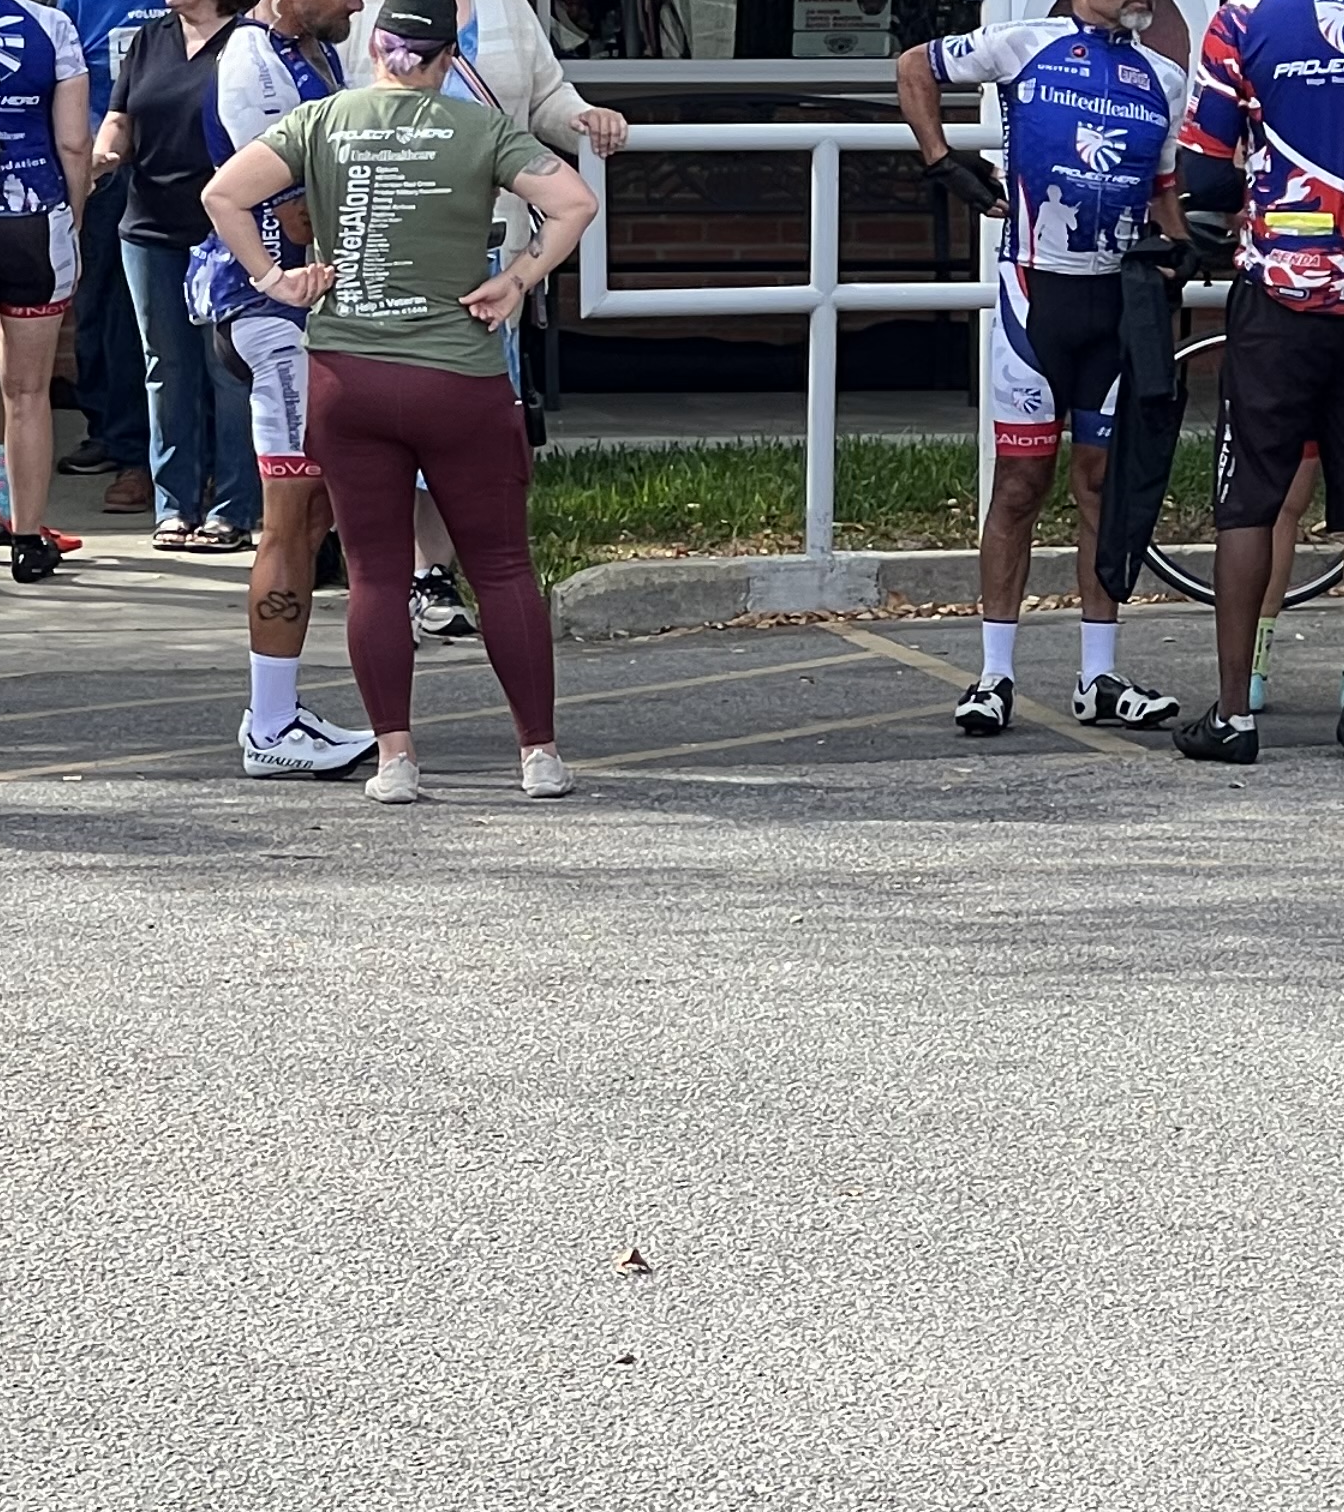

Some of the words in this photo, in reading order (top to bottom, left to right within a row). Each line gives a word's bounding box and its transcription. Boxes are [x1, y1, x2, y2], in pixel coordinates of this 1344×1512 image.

[1037, 64, 1078, 74] UNITED
[350, 149, 438, 162] UnitedHealthcare
[332, 164, 372, 304] #NoVetAlone
[1270, 249, 1321, 267] KENDA
